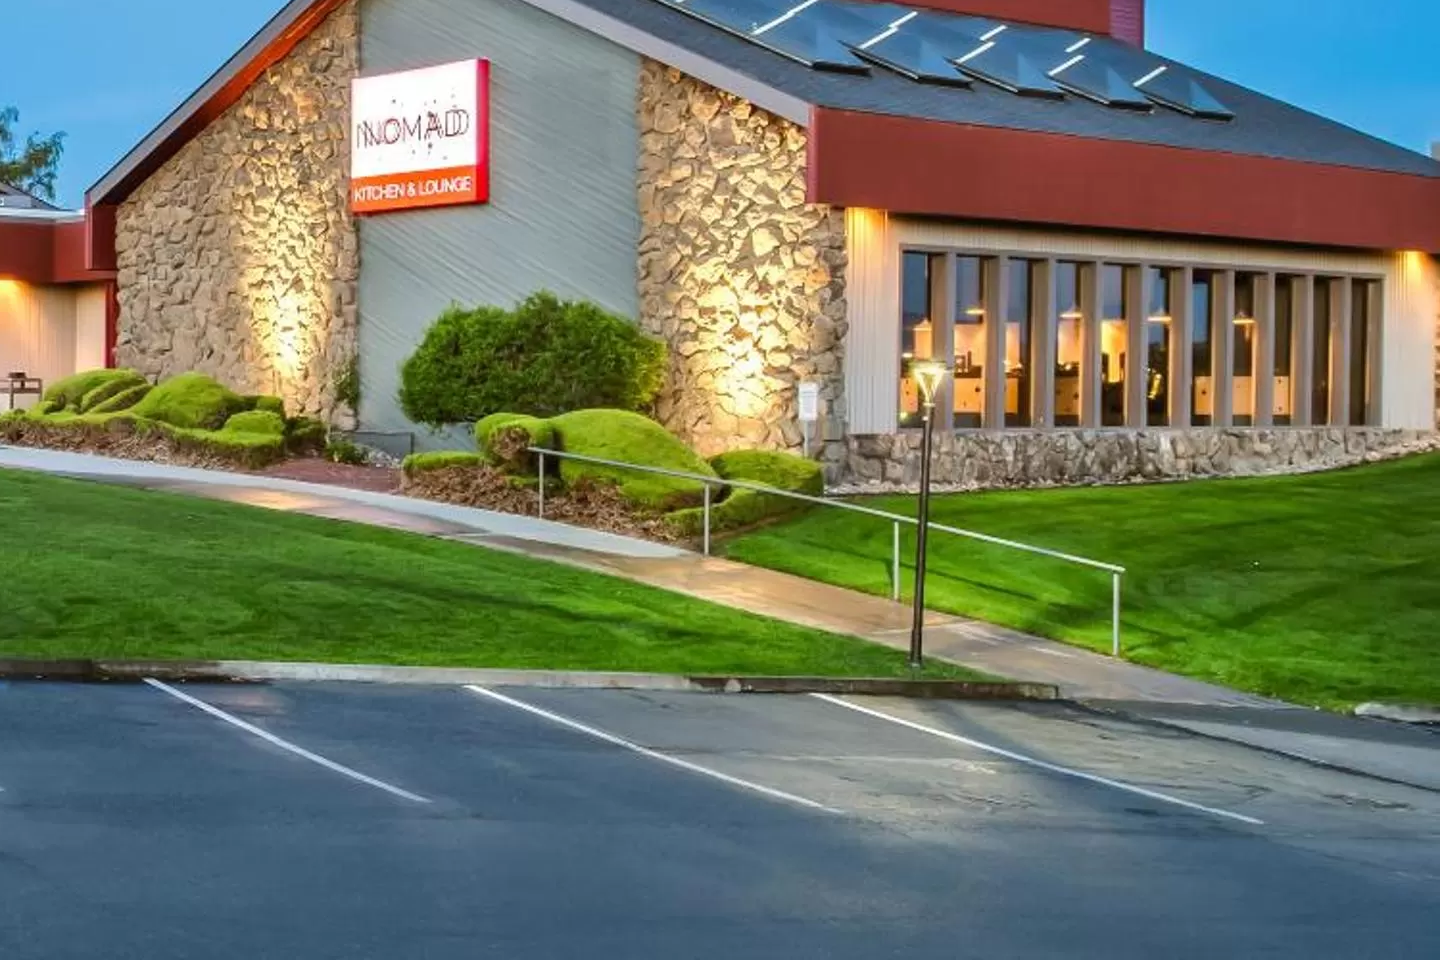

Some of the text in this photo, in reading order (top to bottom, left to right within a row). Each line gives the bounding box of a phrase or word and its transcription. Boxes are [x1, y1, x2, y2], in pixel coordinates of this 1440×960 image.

[356, 108, 470, 148] NOMAD
[354, 176, 472, 202] KITCHEN & LOUNGE
